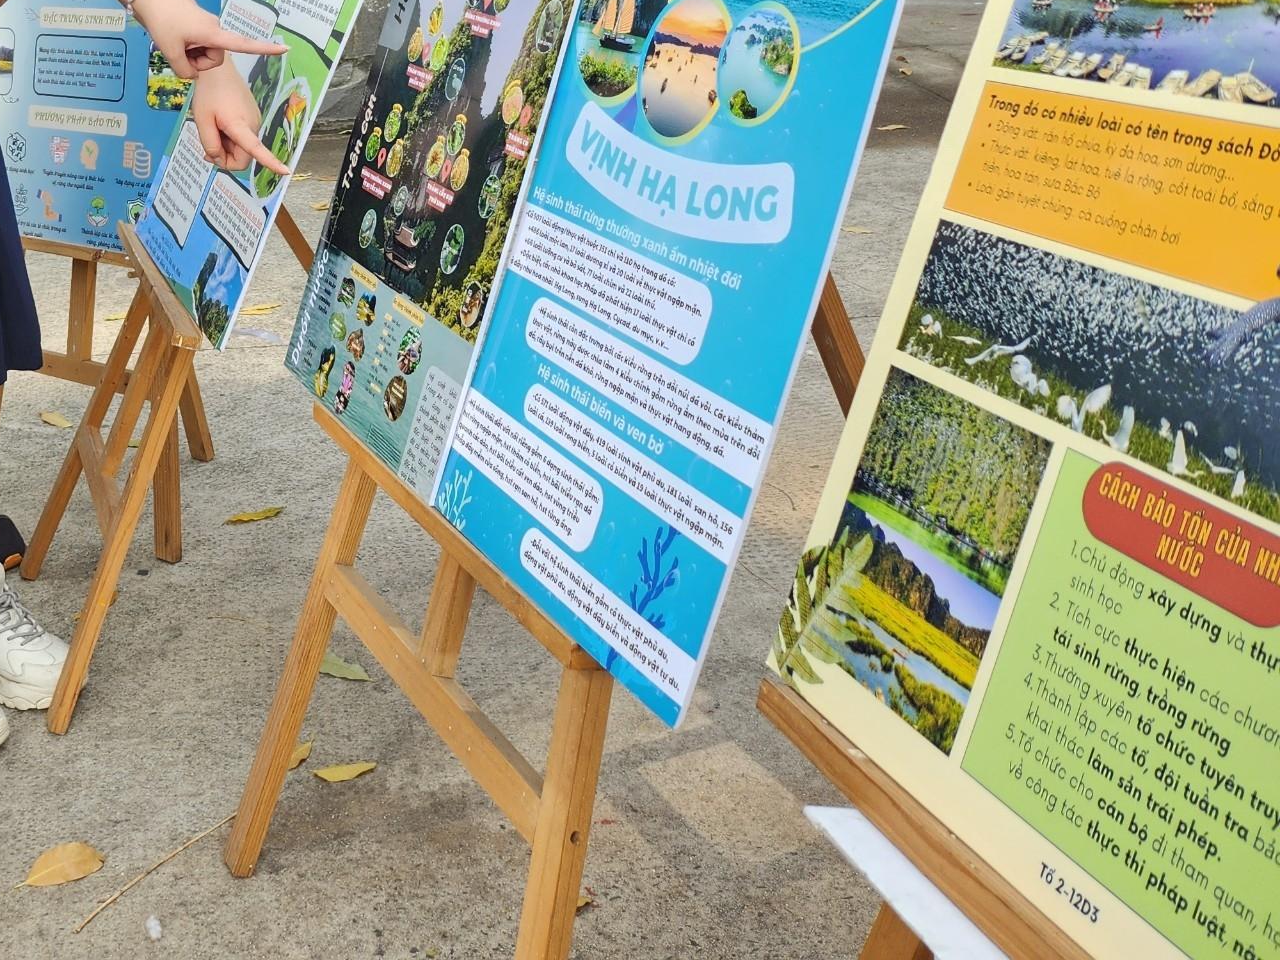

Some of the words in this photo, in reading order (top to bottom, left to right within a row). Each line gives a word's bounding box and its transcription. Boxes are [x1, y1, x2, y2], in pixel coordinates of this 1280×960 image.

[342, 137, 362, 190] Trên
[578, 120, 633, 188] VỊNH
[638, 165, 676, 216] HẠ
[684, 181, 778, 222] LONG
[989, 94, 1021, 118] Trong
[1022, 99, 1039, 117] đó
[1040, 108, 1057, 120] có
[1058, 106, 1094, 127] nhiều
[1096, 111, 1123, 132] loài
[1124, 121, 1142, 136] có
[1146, 123, 1169, 141] tên
[1172, 128, 1213, 155] trong
[1216, 137, 1254, 157] sách
[532, 185, 546, 205] Hệ
[544, 191, 564, 210] sinh
[564, 200, 584, 218] thái
[581, 209, 605, 231] rừng
[605, 218, 642, 248] thường
[641, 236, 668, 258] xanh
[688, 257, 720, 281] nhiệt
[720, 270, 742, 290] đới
[536, 362, 551, 383] Hệ
[549, 372, 570, 394] sinh
[570, 384, 591, 407] thái
[612, 413, 626, 431] và
[626, 423, 647, 445] ven
[646, 433, 665, 455] bờ
[719, 520, 734, 535] 156
[1099, 472, 1141, 511] CÁCH
[1142, 490, 1176, 528] BẢO
[1179, 509, 1213, 547] TỒN
[1215, 526, 1250, 567] CỦA
[1156, 534, 1204, 577] NƯỚC
[1069, 575, 1094, 599] sinh
[1096, 584, 1123, 615] học
[1109, 561, 1145, 600] động
[1147, 588, 1177, 616] xây
[1179, 602, 1222, 643] dựng
[1226, 631, 1245, 653] và
[1052, 626, 1073, 649] tái
[1073, 642, 1101, 669] sinh
[1146, 686, 1187, 729] trồng
[1190, 718, 1231, 758] rừng
[1066, 599, 1091, 630] Tích
[1093, 623, 1121, 647] cực
[1123, 637, 1159, 670] thực
[1161, 658, 1195, 694] hiện
[1199, 688, 1230, 715] các
[1025, 702, 1054, 736] khai
[1054, 725, 1085, 759] thác
[1086, 747, 1114, 781] lâm
[1116, 775, 1142, 802] sản
[1146, 792, 1175, 825] trái
[1174, 819, 1221, 861] phép.
[1074, 703, 1097, 736] lập
[1099, 728, 1127, 755] các
[1130, 745, 1150, 774] tổ,
[1153, 762, 1181, 792] đội
[1183, 782, 1219, 820] tuần
[1223, 811, 1249, 842] tra
[1092, 689, 1132, 724] xuyên
[1136, 714, 1155, 736] tổ
[1155, 730, 1195, 766] chức
[1200, 757, 1245, 800] tuyên
[1008, 757, 1024, 780] về
[1025, 776, 1058, 810] công
[1060, 799, 1083, 828] tác
[1086, 819, 1121, 857] thực
[1124, 849, 1146, 877] thi
[1145, 872, 1188, 914] pháp
[1191, 899, 1227, 946] luật,
[1034, 746, 1067, 780] chức
[1068, 773, 1094, 801] cho
[1097, 797, 1125, 825] cán
[1127, 812, 1148, 845] bộ
[1151, 834, 1168, 857] đi
[1170, 847, 1209, 890] tham
[1213, 885, 1257, 931] quan,
[1040, 862, 1056, 885] Tổ
[1056, 878, 1100, 923] 2-12D3
